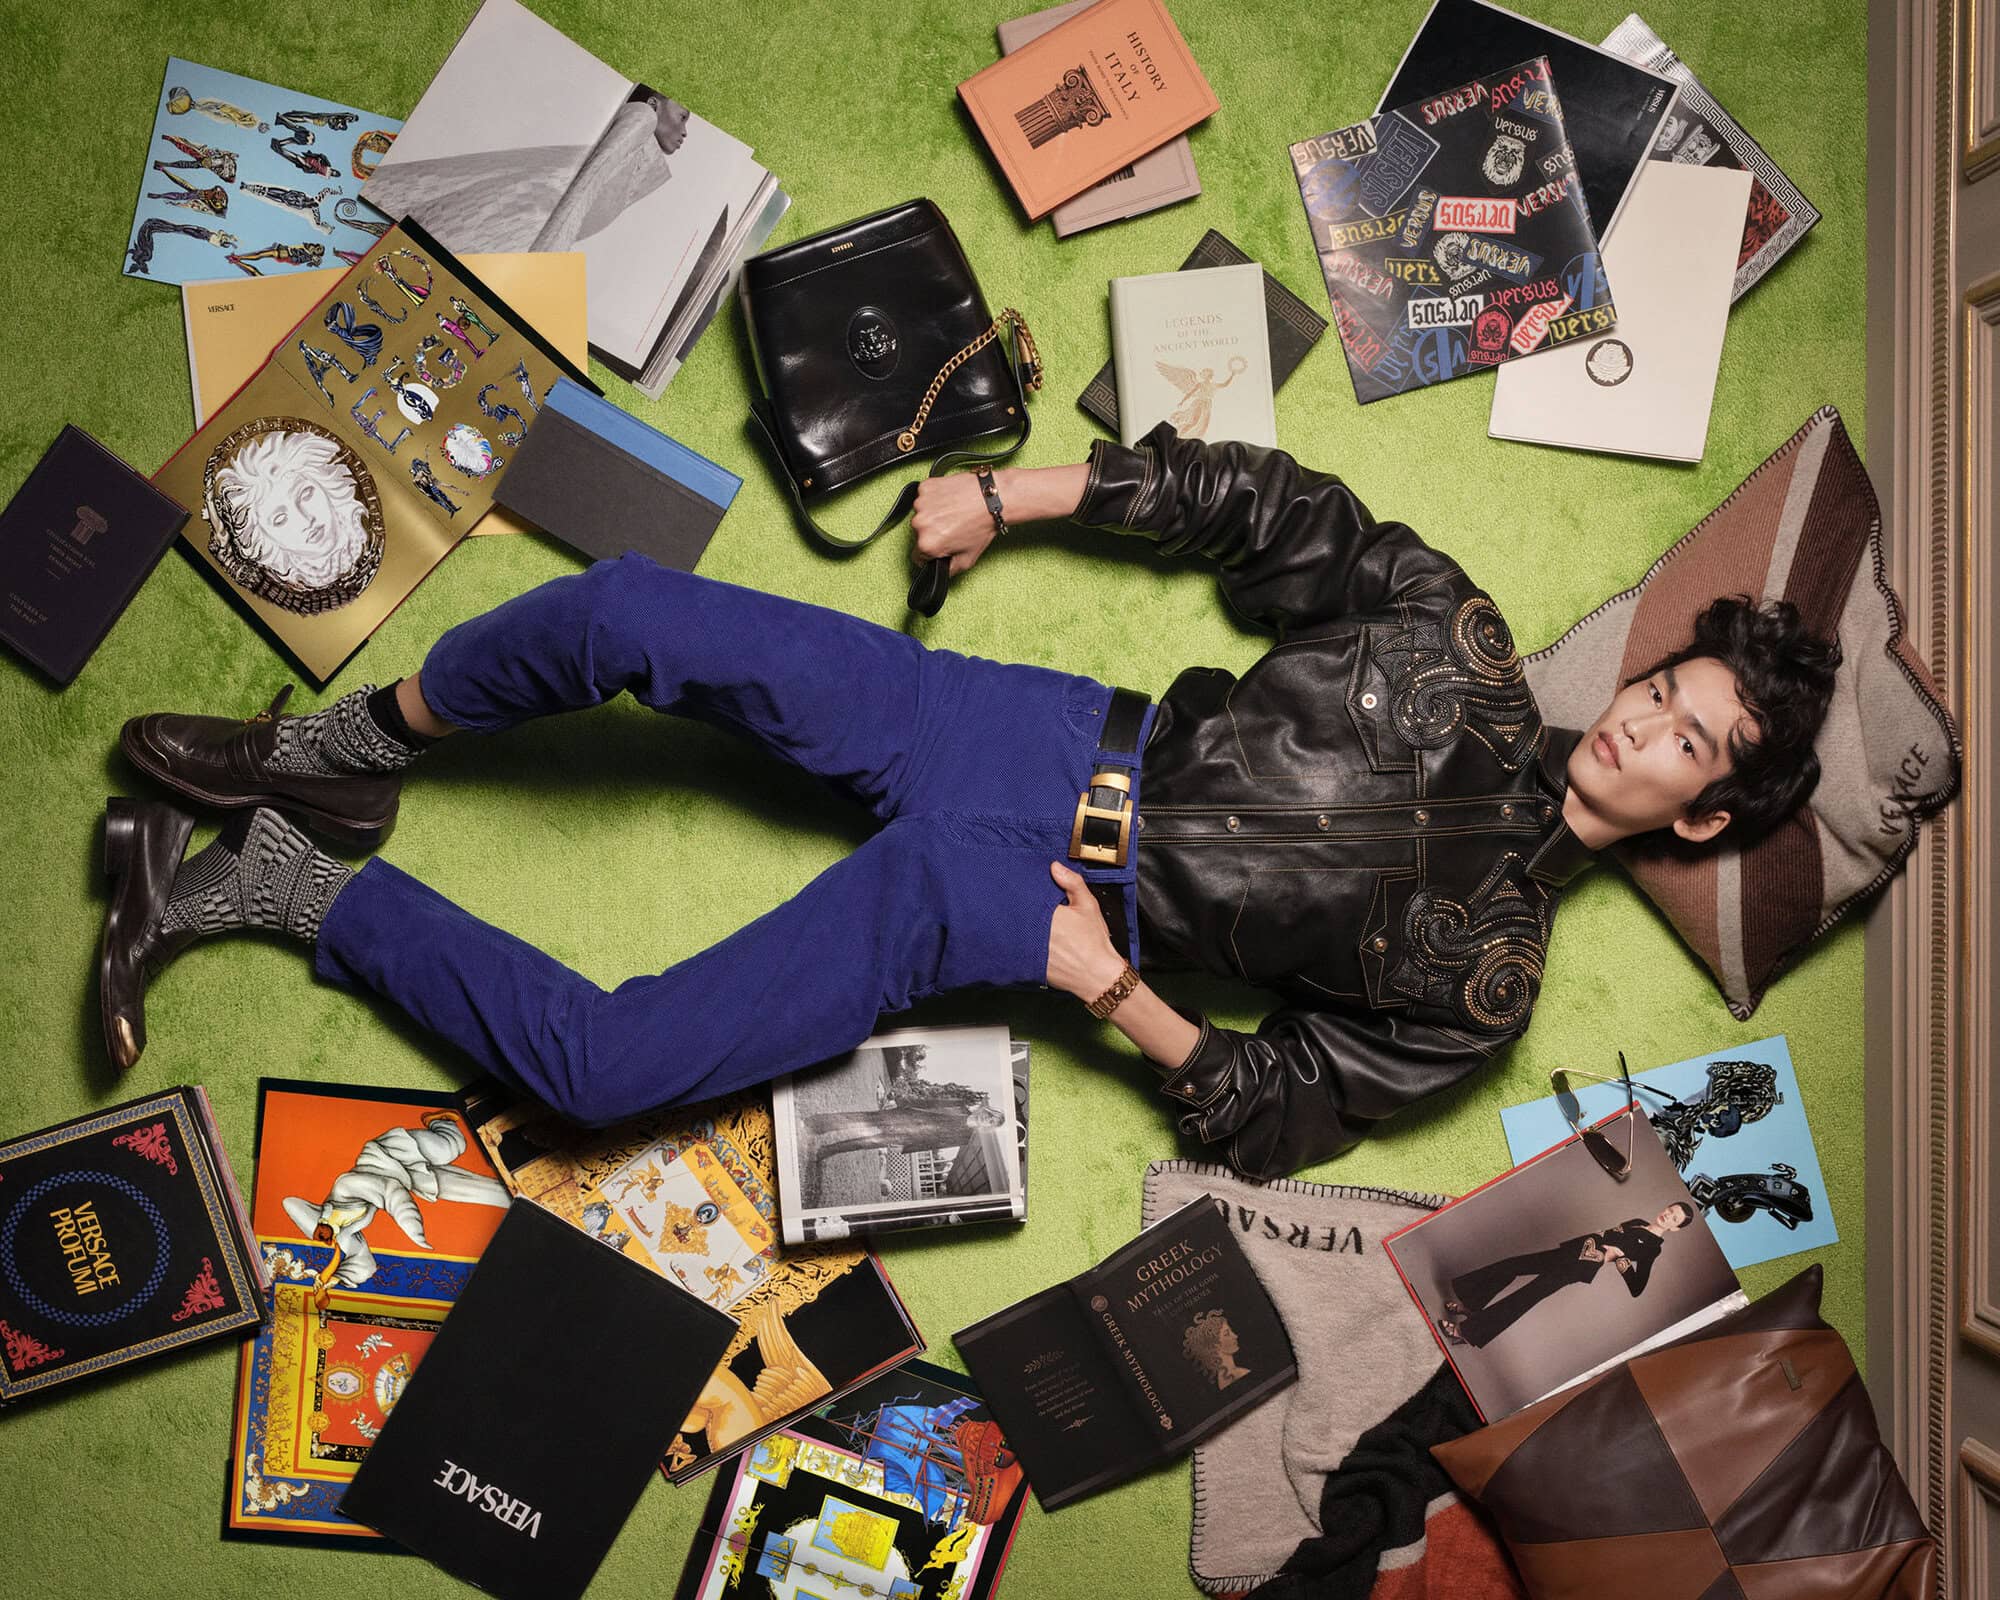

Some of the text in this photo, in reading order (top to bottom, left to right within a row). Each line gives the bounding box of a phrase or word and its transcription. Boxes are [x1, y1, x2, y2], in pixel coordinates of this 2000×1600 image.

[1105, 52, 1140, 101] ITALY
[1127, 31, 1167, 92] HISTORY
[1130, 64, 1139, 74] OF
[1153, 336, 1239, 352] ANCIENT WORLD
[1164, 312, 1224, 328] LEGENDS
[50, 1208, 98, 1295] PROFUMI
[74, 1201, 120, 1290] VERSACE
[1136, 1239, 1194, 1282] GREEK
[1127, 1242, 1224, 1313] MYTHOLOGY
[1102, 1313, 1165, 1414] GREEK MYTHOLOGY
[433, 1459, 542, 1539] VERSACE
